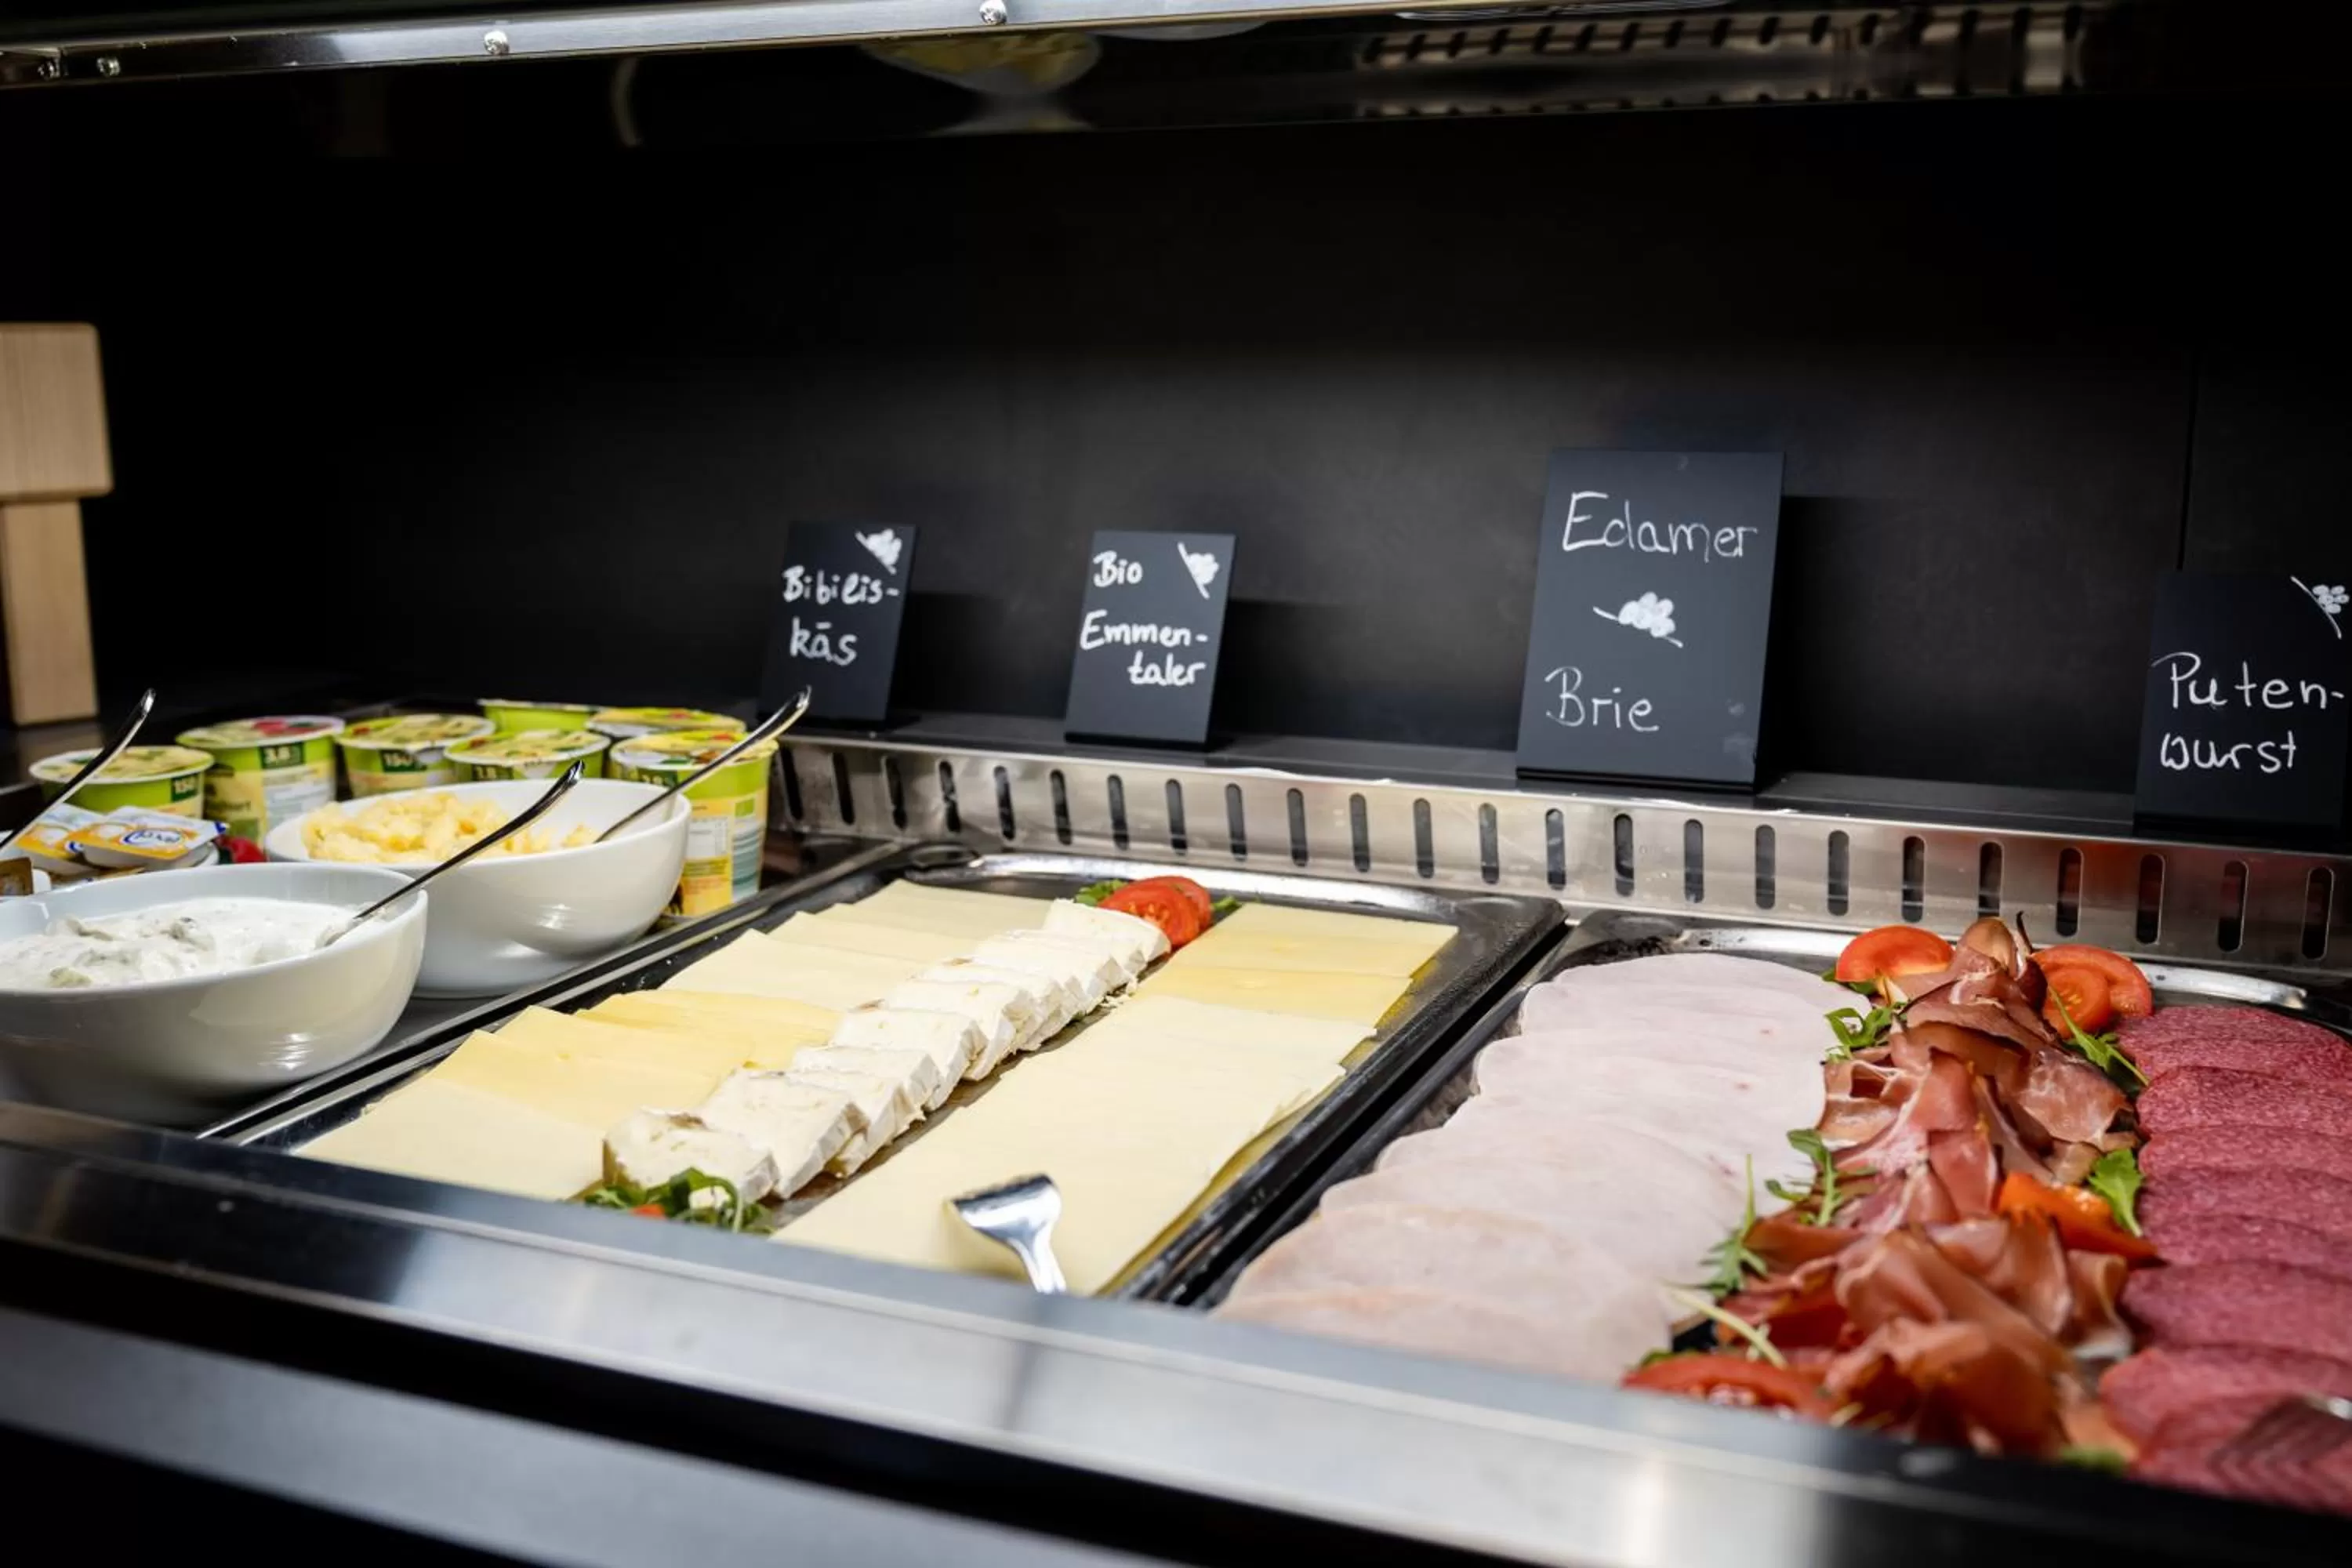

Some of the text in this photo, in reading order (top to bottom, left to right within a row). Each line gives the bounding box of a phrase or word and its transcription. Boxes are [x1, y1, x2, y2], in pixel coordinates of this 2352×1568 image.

[1563, 490, 1759, 564] Edamer
[1093, 550, 1143, 587] Bio
[1080, 609, 1208, 650] Emmen-
[1127, 650, 1207, 686] taler
[2151, 652, 2345, 709] Puten-
[1544, 666, 1660, 731] Brie
